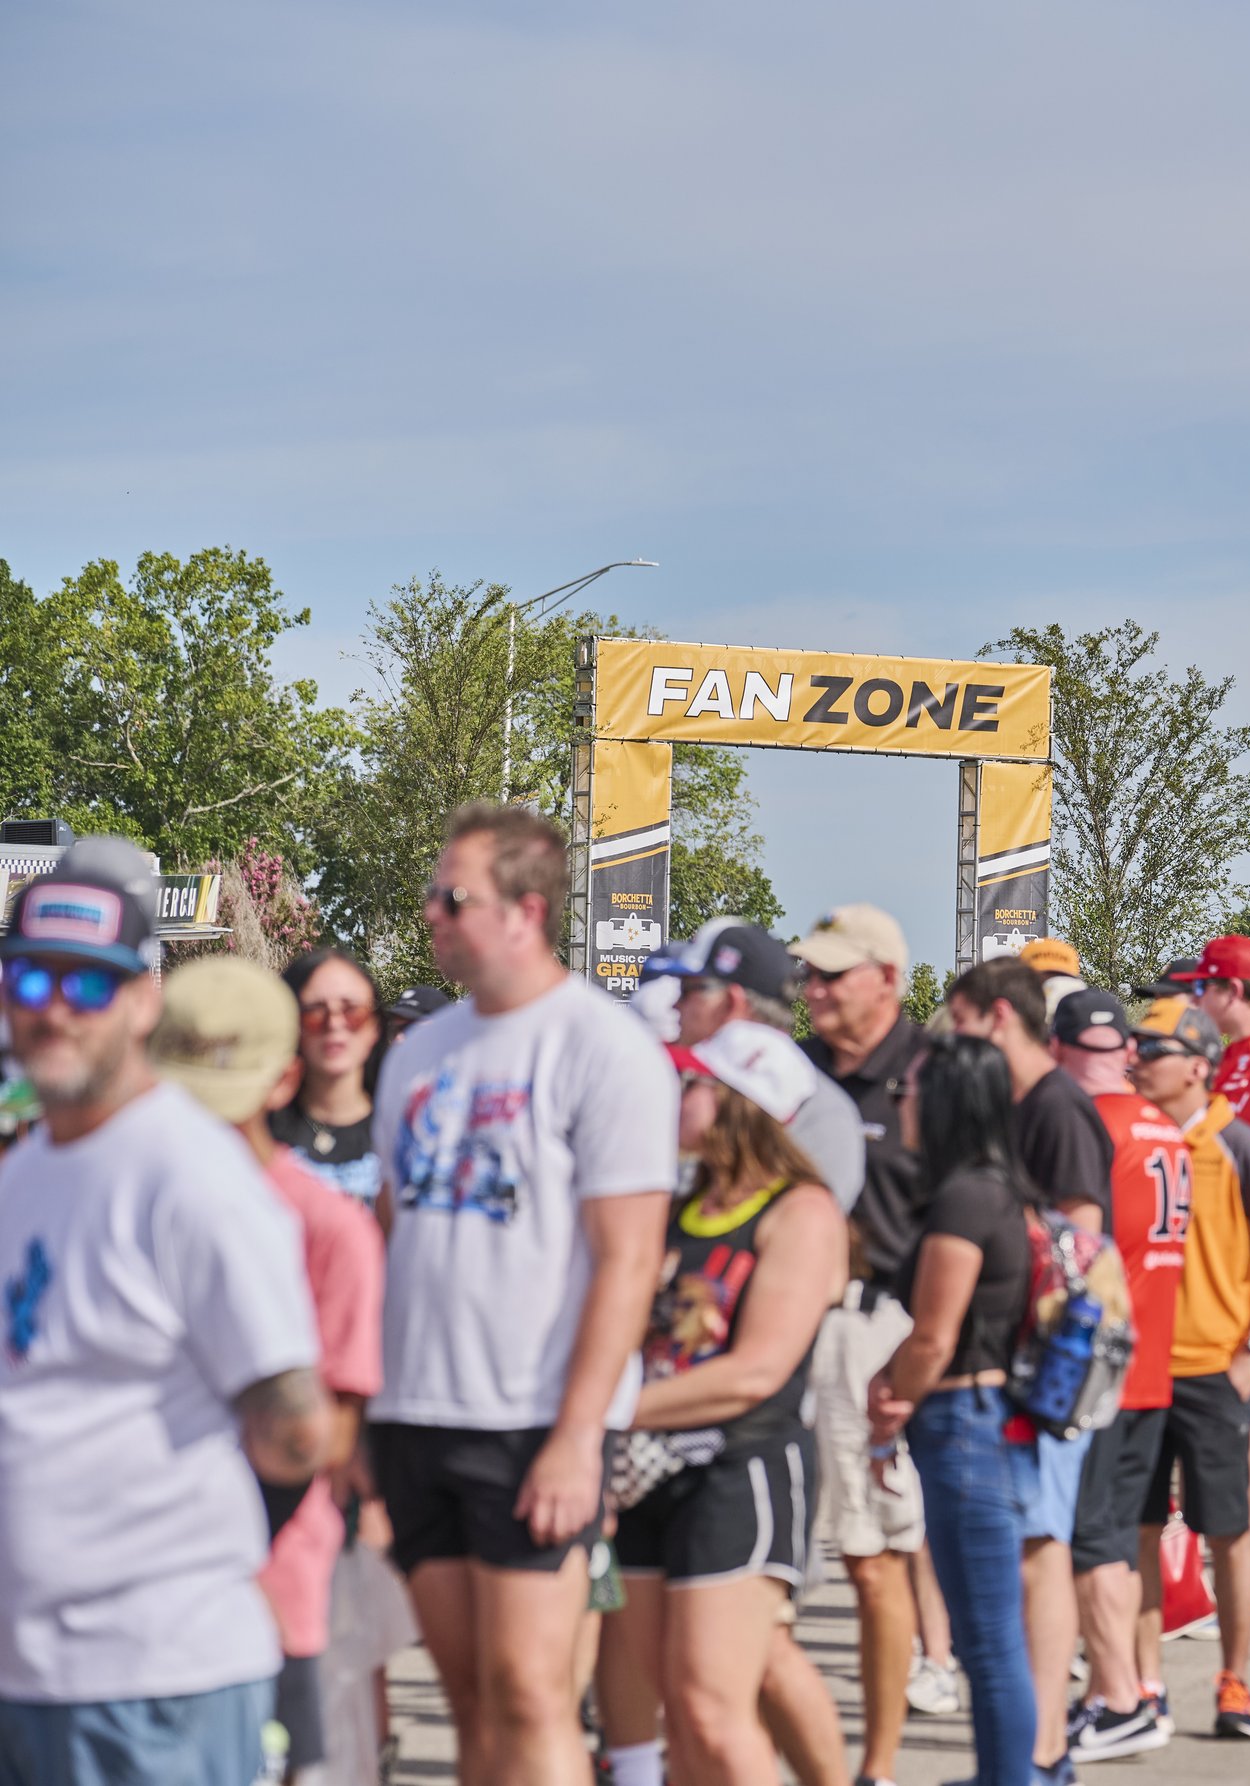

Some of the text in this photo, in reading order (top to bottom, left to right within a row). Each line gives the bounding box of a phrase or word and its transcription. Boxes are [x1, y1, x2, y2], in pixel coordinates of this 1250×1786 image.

[647, 666, 1005, 732] FAN ZONE
[611, 893, 654, 905] BORCHETTA
[994, 909, 1037, 920] BORCHETTA
[600, 954, 650, 963] MUSIC CI
[596, 963, 643, 977] GRA
